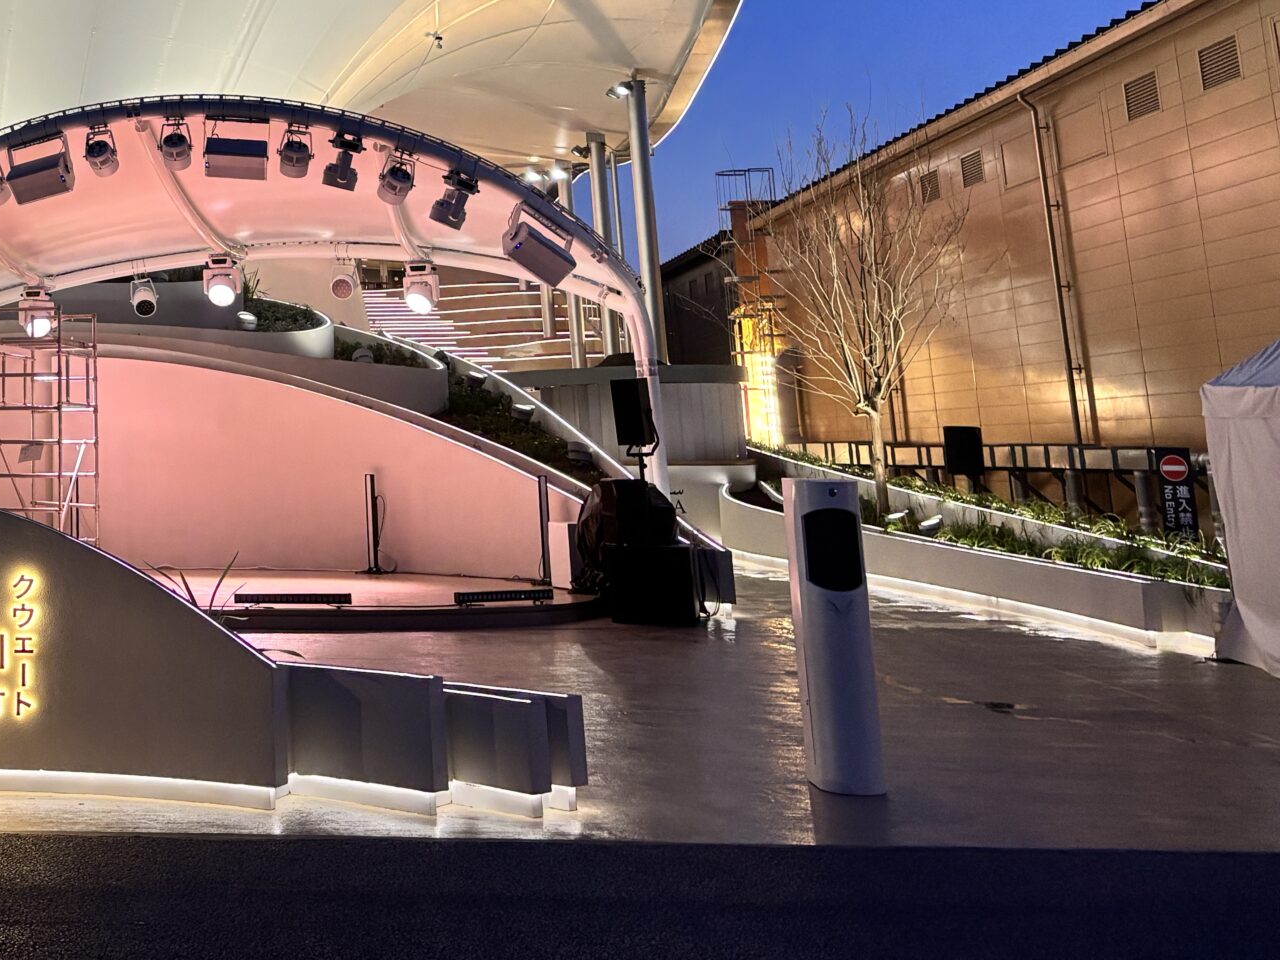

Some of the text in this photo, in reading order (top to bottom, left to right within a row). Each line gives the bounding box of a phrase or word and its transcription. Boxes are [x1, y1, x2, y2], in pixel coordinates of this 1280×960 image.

[1163, 485, 1176, 529] No Entry
[1176, 485, 1196, 539] 進入禁止
